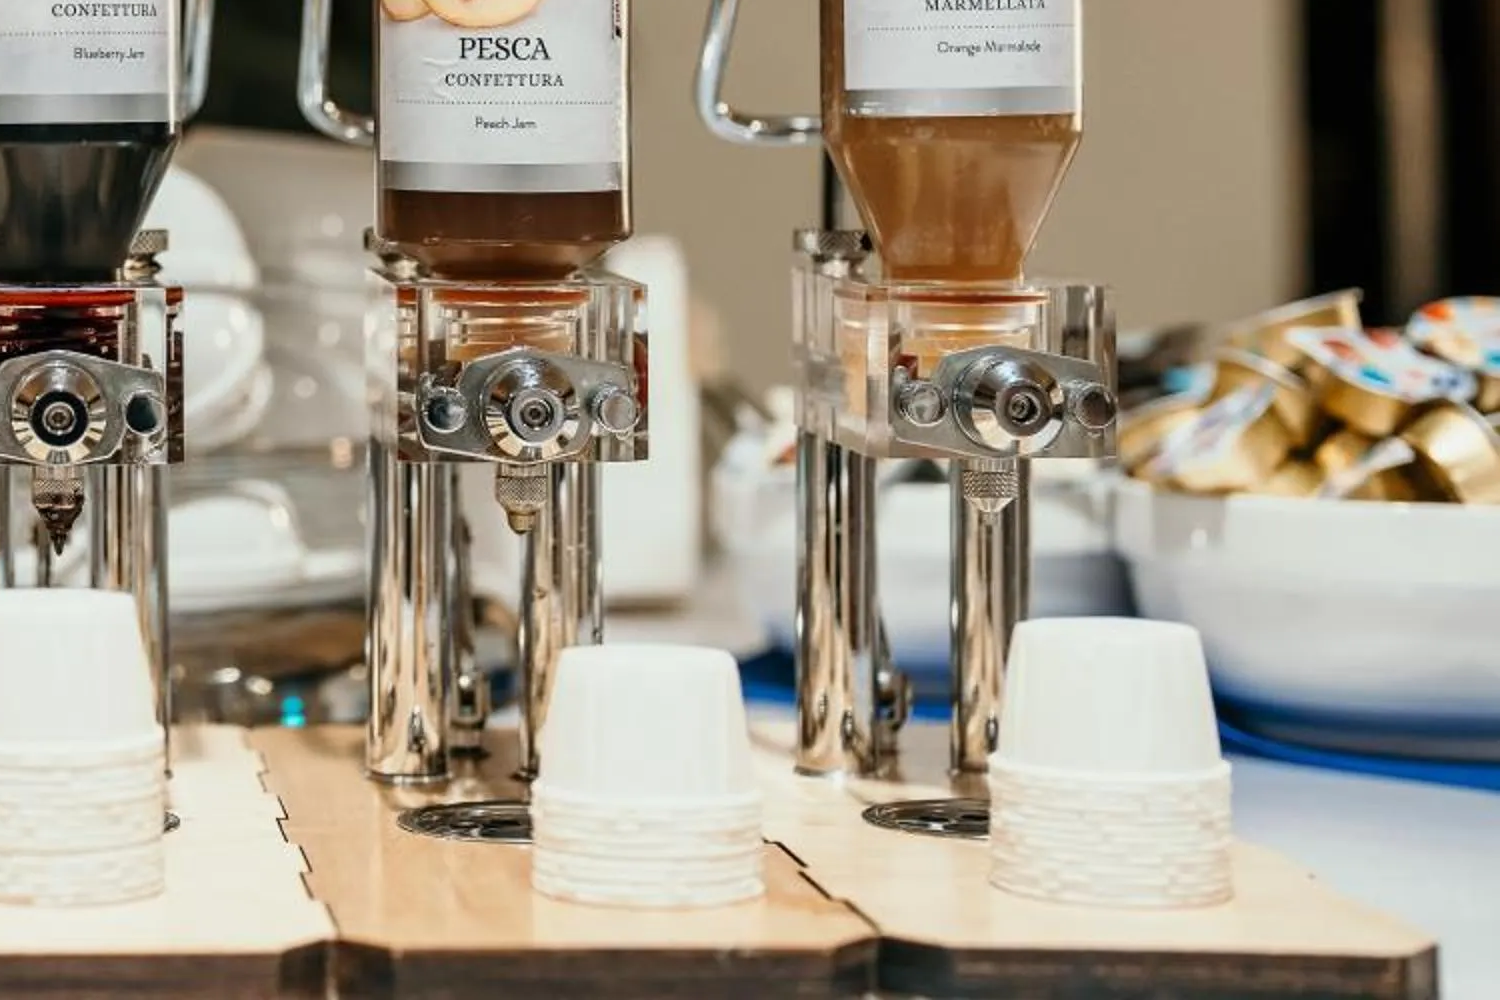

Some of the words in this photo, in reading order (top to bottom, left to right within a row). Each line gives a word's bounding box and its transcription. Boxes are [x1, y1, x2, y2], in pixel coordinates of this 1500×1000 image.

[51, 3, 157, 18] CONFETTURA
[73, 47, 126, 62] Blueberry
[458, 37, 551, 61] PESCA
[937, 40, 981, 57] Orange
[444, 73, 564, 87] CONFETTURA
[475, 117, 510, 130] Peach
